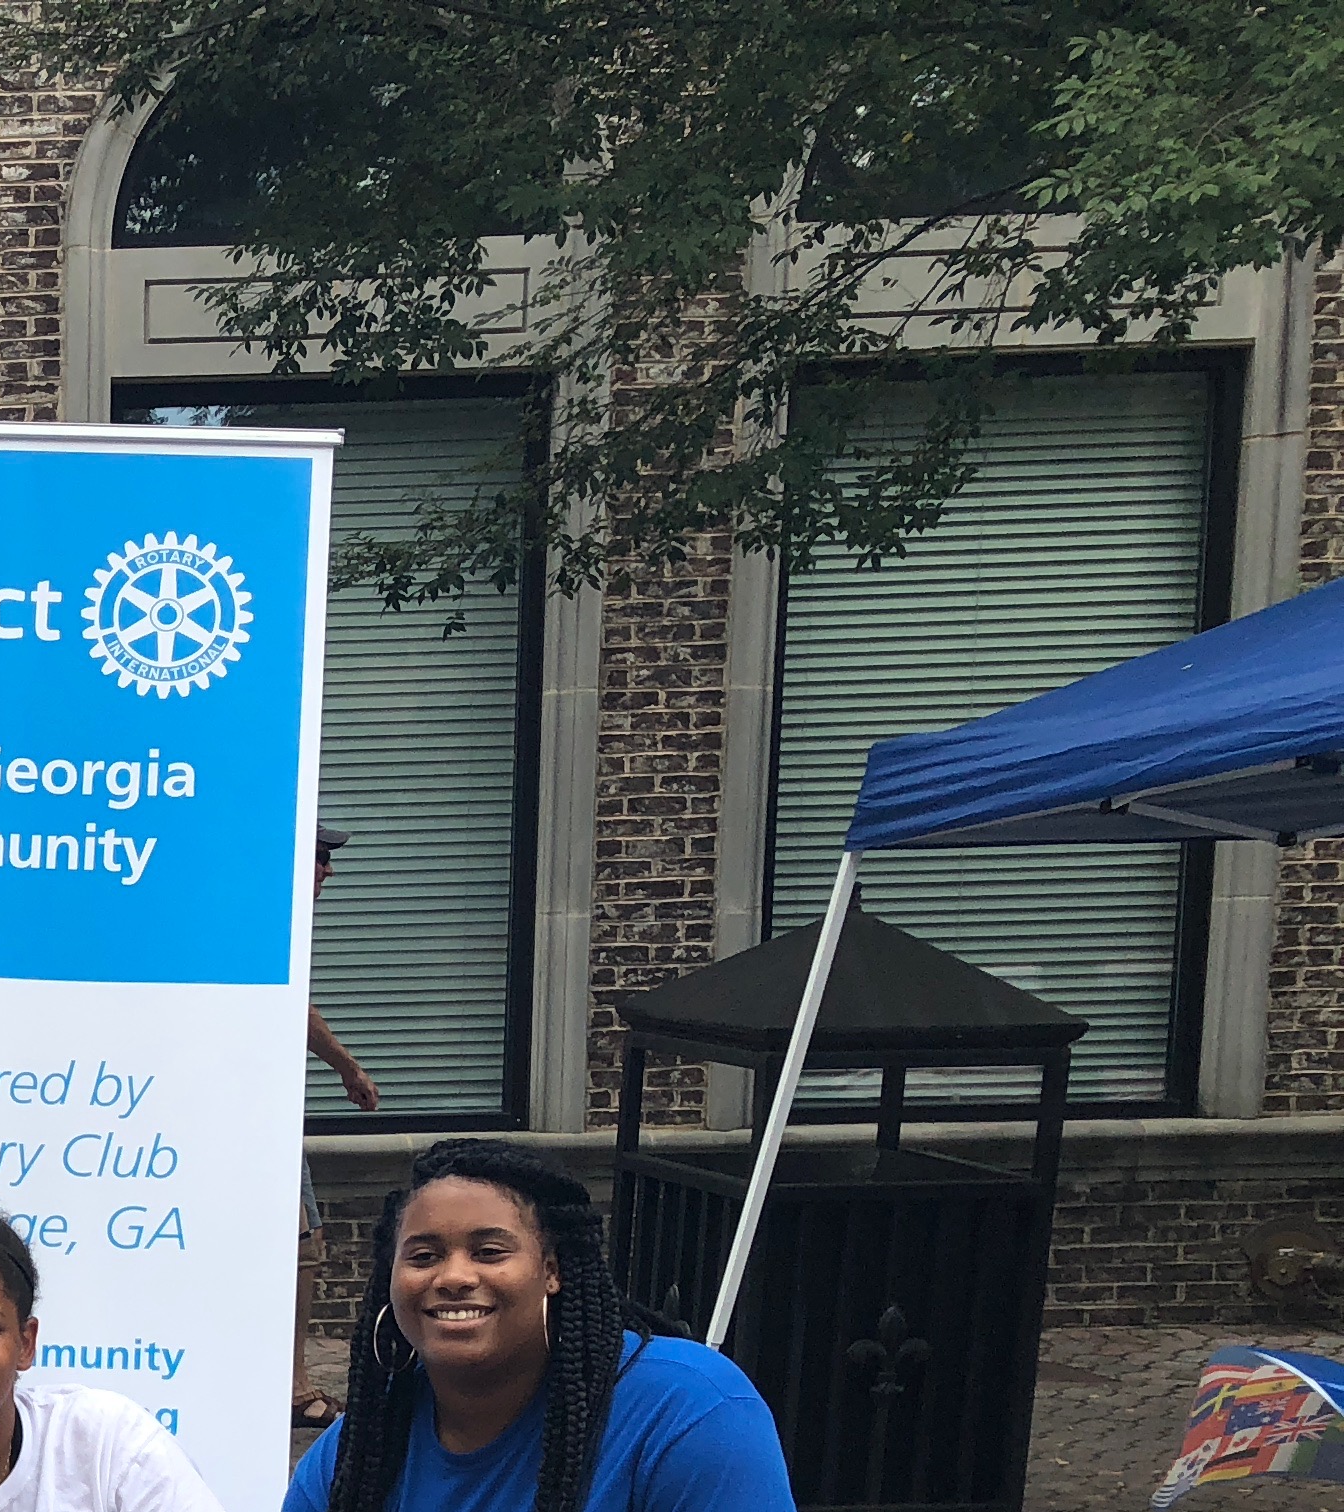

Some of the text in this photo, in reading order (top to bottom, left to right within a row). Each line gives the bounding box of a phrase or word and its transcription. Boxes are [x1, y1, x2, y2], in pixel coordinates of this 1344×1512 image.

[135, 549, 206, 570] ROTARY
[108, 638, 228, 681] INTERNATIONAL
[89, 1060, 155, 1119] by
[62, 1131, 179, 1180] Club
[106, 1204, 187, 1251] GA
